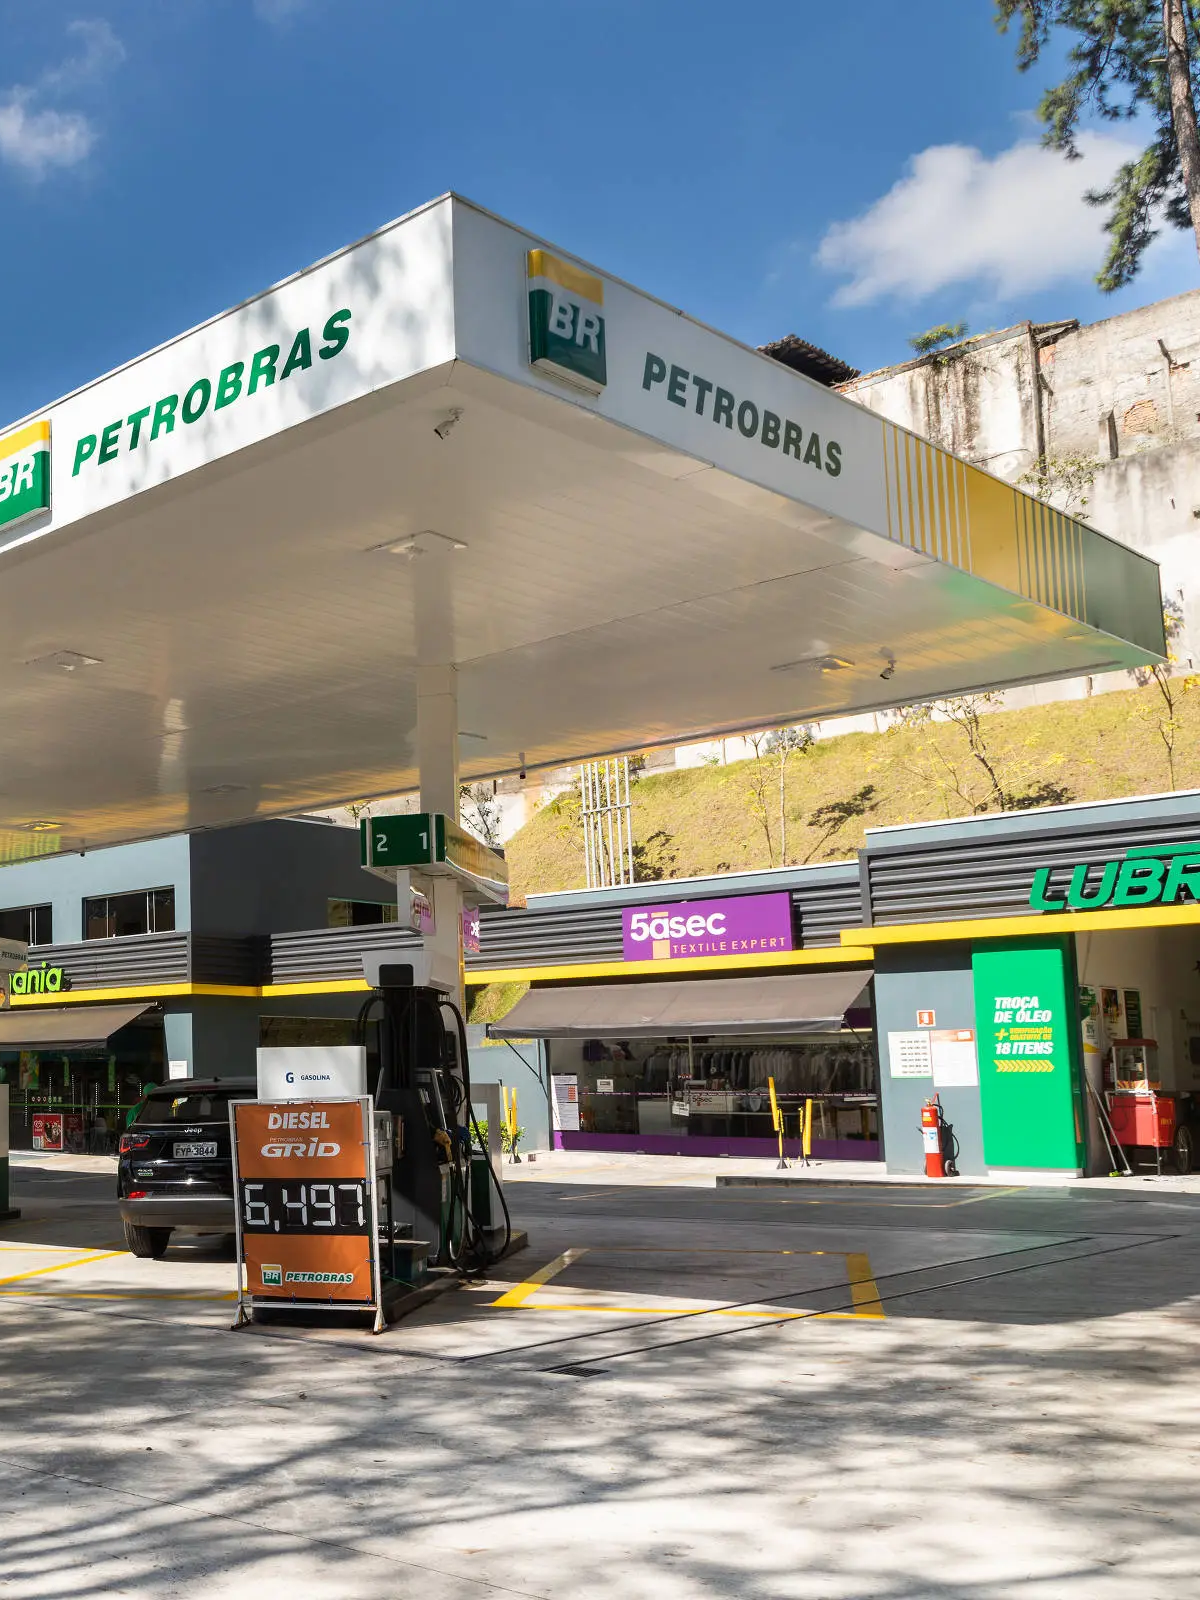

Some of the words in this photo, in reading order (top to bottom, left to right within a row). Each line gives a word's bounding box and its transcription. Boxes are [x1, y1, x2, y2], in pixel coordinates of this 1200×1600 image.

[548, 295, 601, 354] BR
[72, 308, 352, 478] PETROBRAS
[642, 351, 842, 478] PETROBRAS
[376, 834, 388, 852] 2
[418, 832, 428, 850] 1
[672, 942, 727, 954] TEXTILE
[731, 937, 786, 950] EXPERT
[9, 961, 62, 994] ania
[993, 1010, 1013, 1023] DE
[1015, 1007, 1053, 1022] ÓLEO
[995, 1042, 1011, 1055] 18
[1012, 1041, 1054, 1055] ITENS
[285, 1072, 295, 1083] G
[267, 1111, 331, 1130] DIESEL
[184, 1126, 203, 1134] Jeep
[260, 1137, 341, 1158] GRID
[244, 1184, 365, 1232] 6,497
[264, 1273, 280, 1281] BR
[285, 1272, 353, 1283] PETROBRAS
